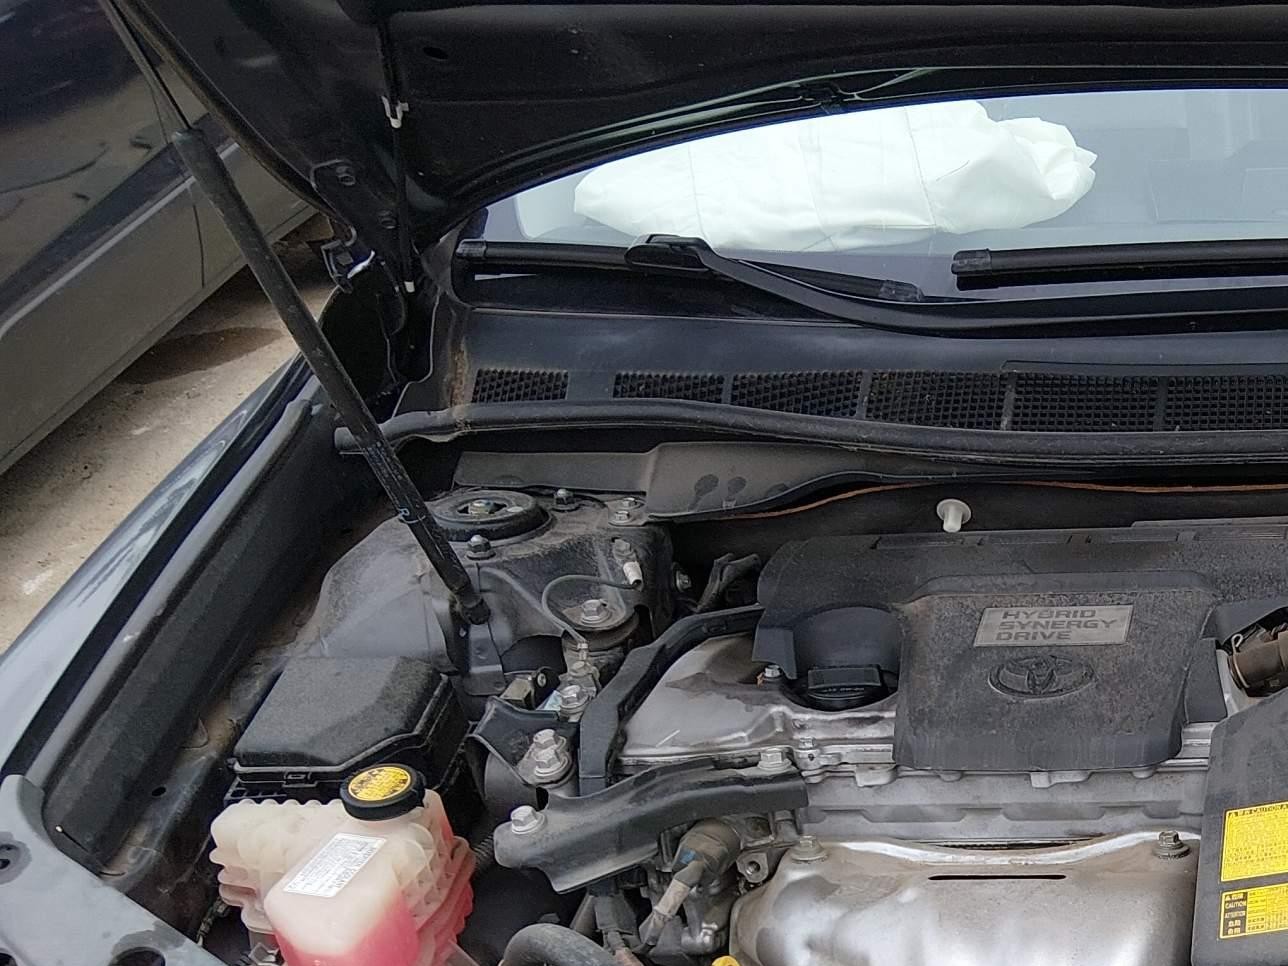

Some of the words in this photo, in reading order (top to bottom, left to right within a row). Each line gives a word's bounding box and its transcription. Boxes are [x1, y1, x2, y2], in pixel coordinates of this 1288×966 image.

[1002, 609, 1096, 619] HYBRID
[999, 619, 1117, 630] SYNERGY
[995, 630, 1073, 641] DRIVE
